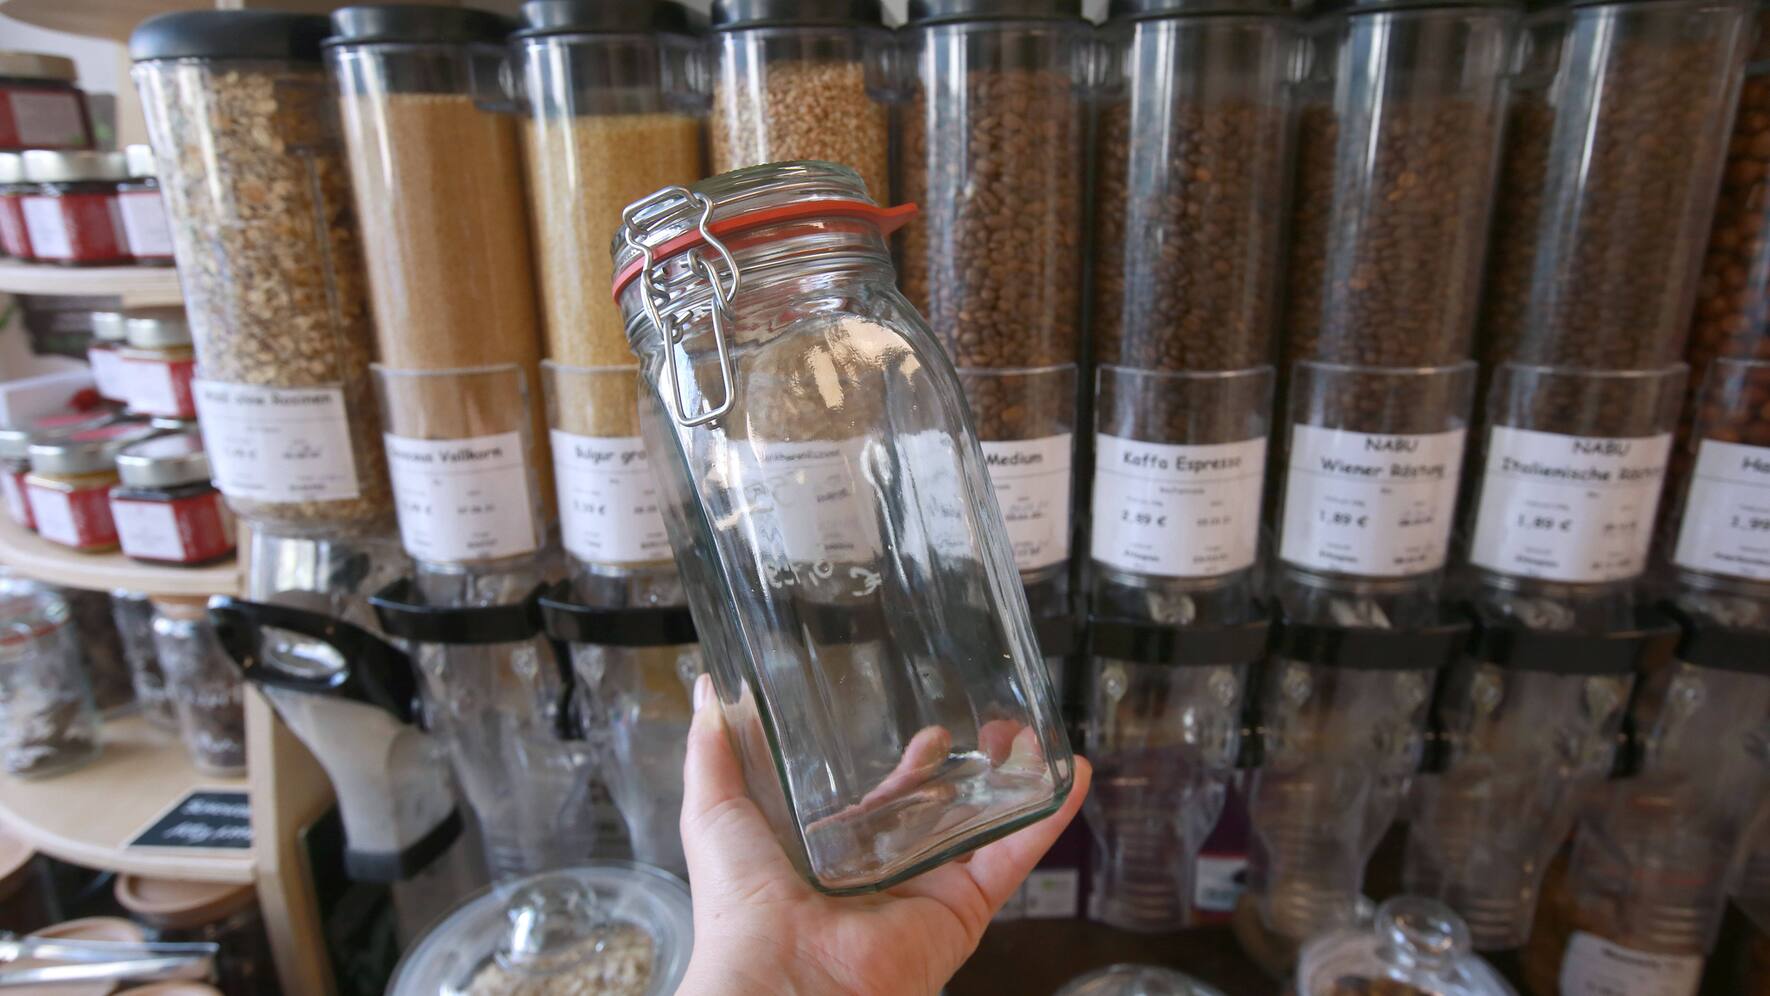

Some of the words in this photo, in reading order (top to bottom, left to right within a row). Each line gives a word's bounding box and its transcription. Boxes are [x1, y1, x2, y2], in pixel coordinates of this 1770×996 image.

[1365, 437, 1419, 451] NABU
[437, 448, 503, 463] Vollkorn
[986, 452, 1043, 465] Medium
[1122, 451, 1168, 469] Kaffa
[1175, 455, 1242, 473] Espresso
[1320, 456, 1383, 477] Wiener
